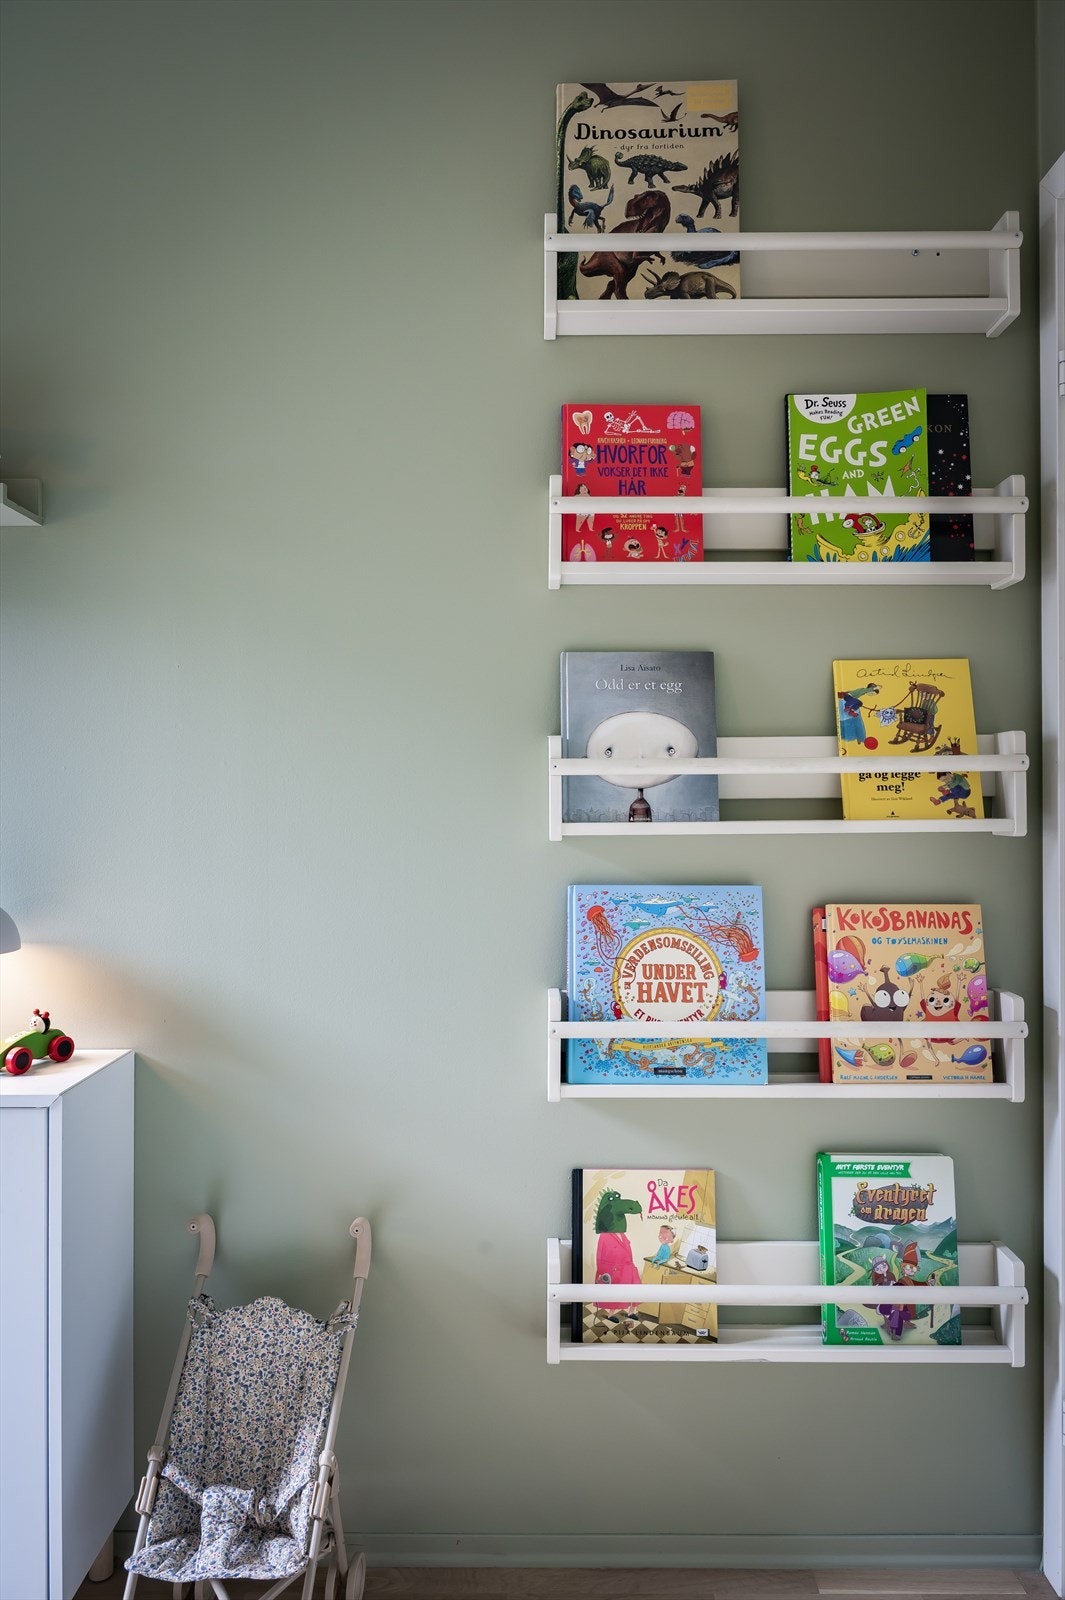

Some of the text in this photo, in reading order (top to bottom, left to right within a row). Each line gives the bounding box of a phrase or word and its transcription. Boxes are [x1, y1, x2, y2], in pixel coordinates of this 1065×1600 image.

[574, 122, 723, 140] Dinosaurium
[620, 142, 684, 151] dyr fra fortiden
[804, 397, 847, 410] Dr. Seuss
[824, 409, 844, 417] Reading
[847, 396, 921, 434] GREEN
[596, 444, 668, 465] HVORFOR
[798, 433, 888, 468] EGGS
[597, 467, 669, 478] VOKSER DET IKKE
[842, 469, 865, 480] AND
[618, 477, 647, 496] HÅR
[620, 664, 662, 672] Lisa Aisato
[856, 665, 900, 679] Astrid
[595, 678, 683, 694] Odd er et egg
[876, 781, 905, 795] meg!
[836, 906, 974, 935] KOKOSBANANAS
[871, 937, 883, 945] OG
[621, 936, 716, 981] VERDENSOMSEILING
[641, 963, 697, 981] UNDER
[636, 981, 709, 1003] HAVET
[633, 1008, 646, 1020] ET
[876, 1164, 905, 1172] EVENTYR
[658, 1178, 669, 1187] Da
[647, 1180, 698, 1215] ÅKES
[855, 1181, 937, 1206] Eventyret
[860, 1204, 928, 1225] om dragen
